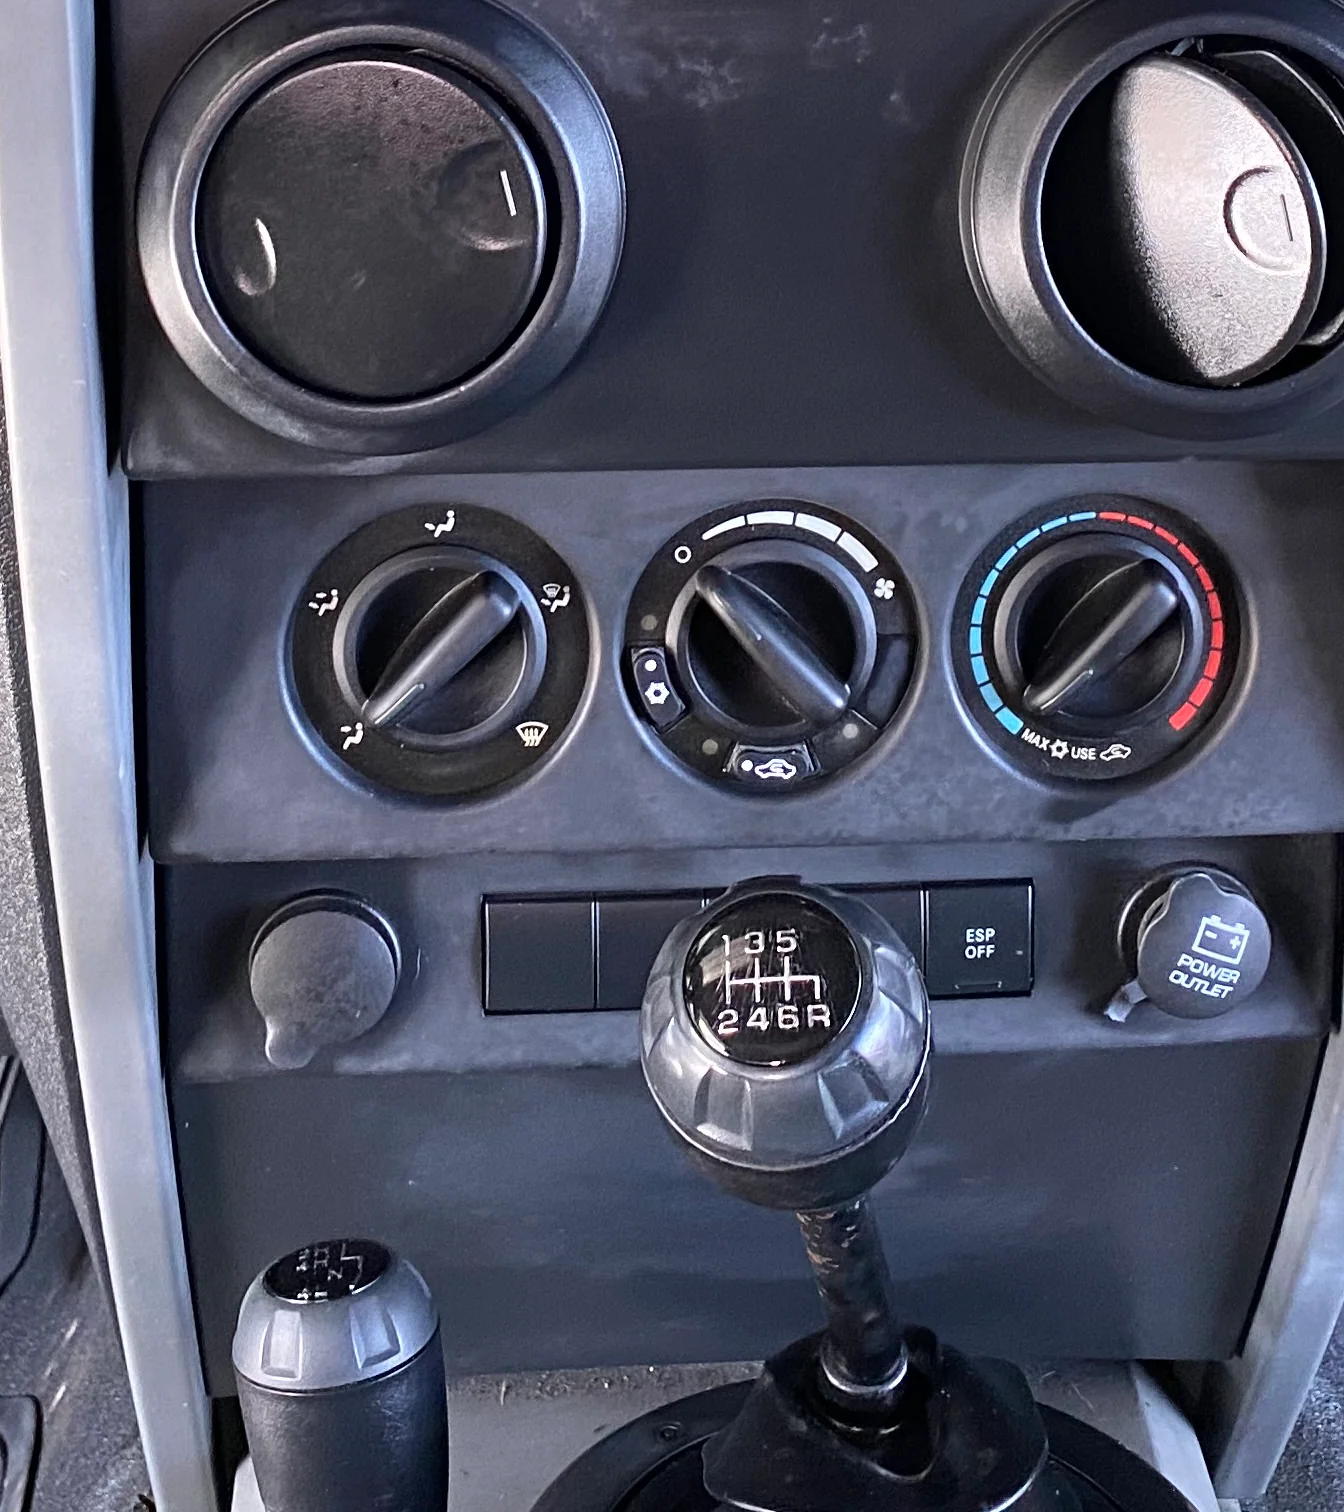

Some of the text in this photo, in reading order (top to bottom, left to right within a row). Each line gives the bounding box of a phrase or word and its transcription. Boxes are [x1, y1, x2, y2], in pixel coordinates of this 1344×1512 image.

[1021, 728, 1096, 760] MAX USE
[721, 928, 798, 956] 1 3 5
[966, 927, 996, 943] ESP
[964, 945, 996, 959] OFF
[1177, 953, 1241, 984] POWER
[1168, 969, 1234, 999] OUTLET
[717, 1004, 831, 1034] 2 4 6 R
